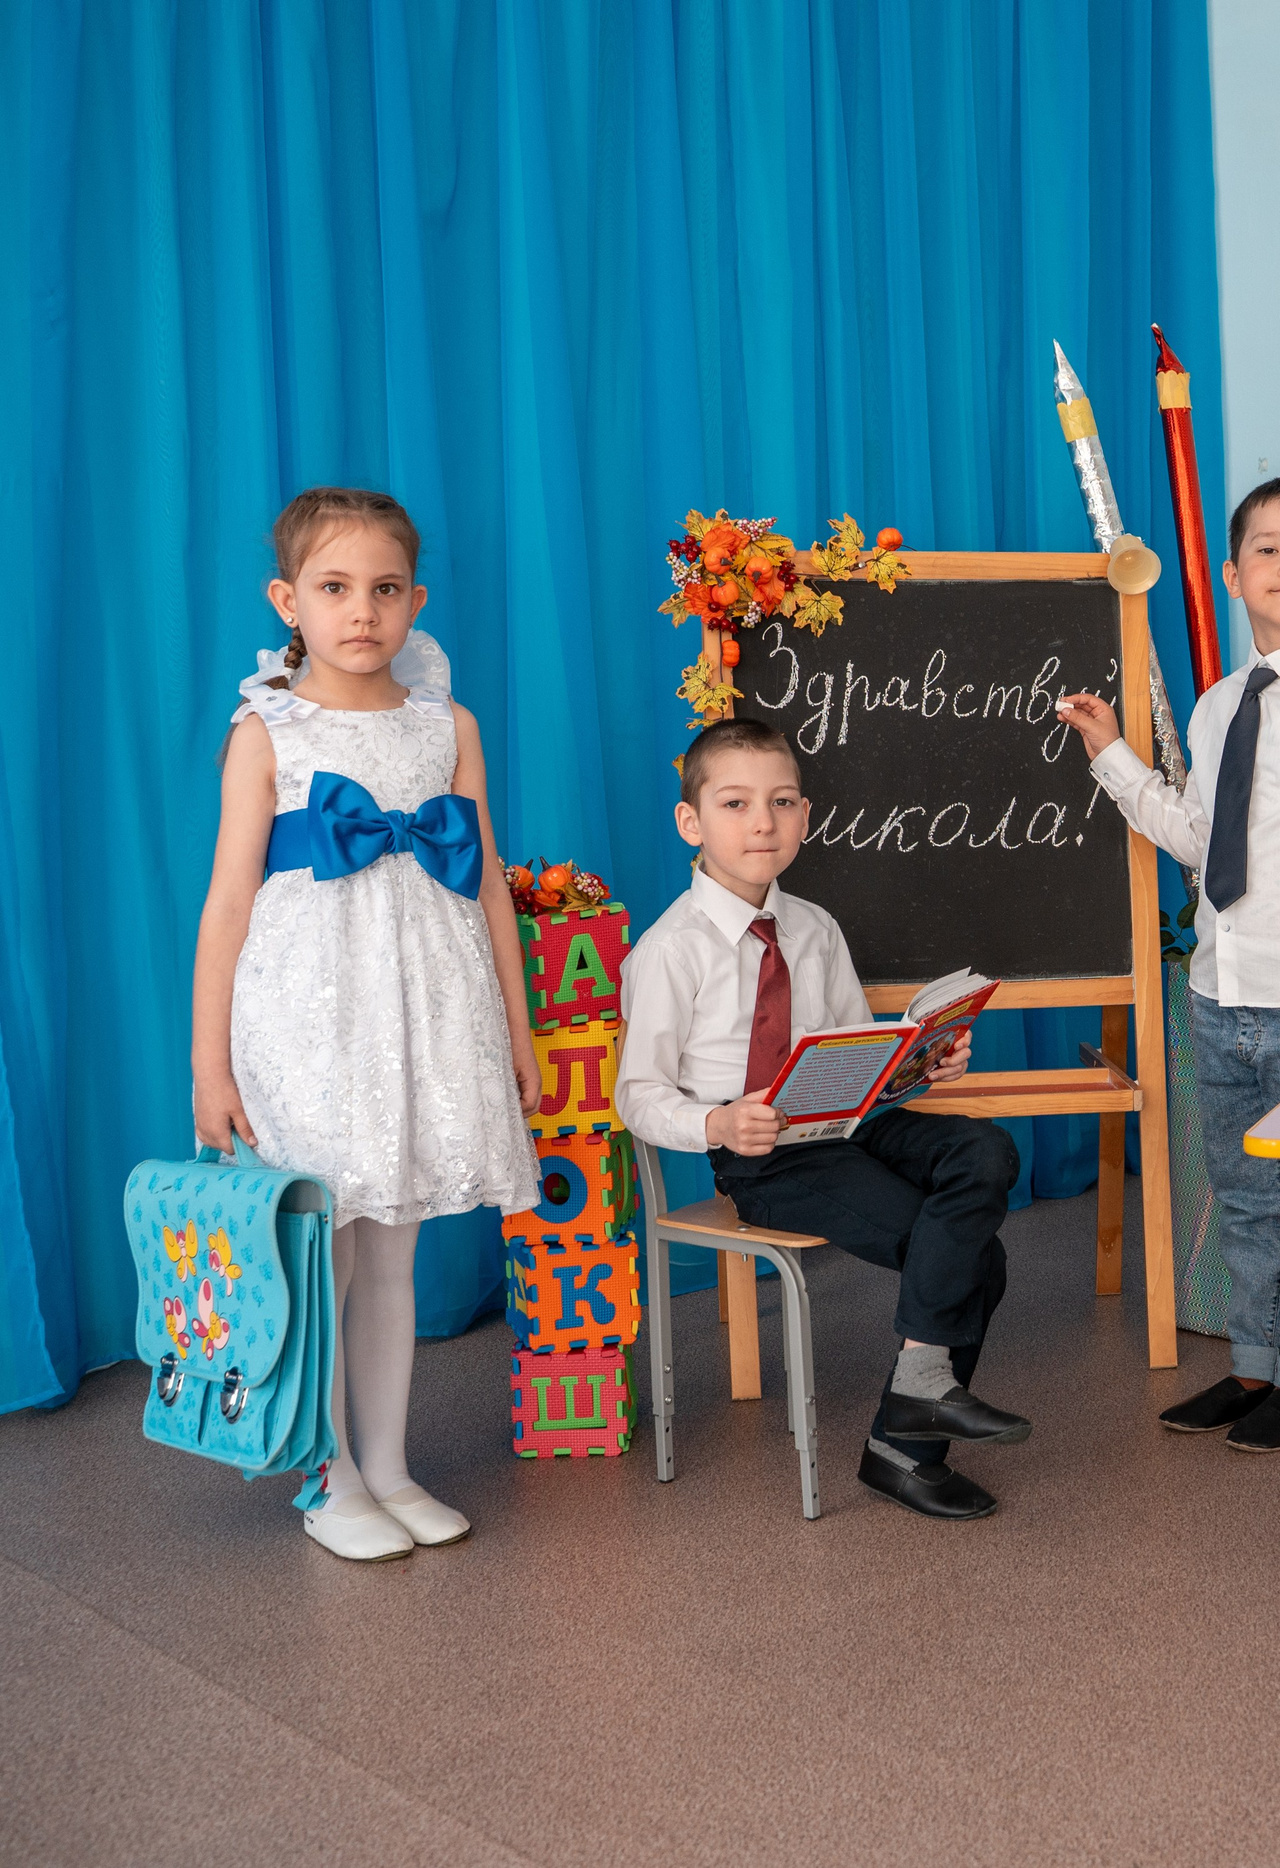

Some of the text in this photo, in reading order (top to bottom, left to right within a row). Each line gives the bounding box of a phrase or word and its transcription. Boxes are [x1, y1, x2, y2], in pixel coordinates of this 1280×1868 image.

[553, 933, 616, 1005] А
[539, 1045, 610, 1116] Л
[552, 1263, 616, 1331] К
[531, 1375, 608, 1431] Ш
